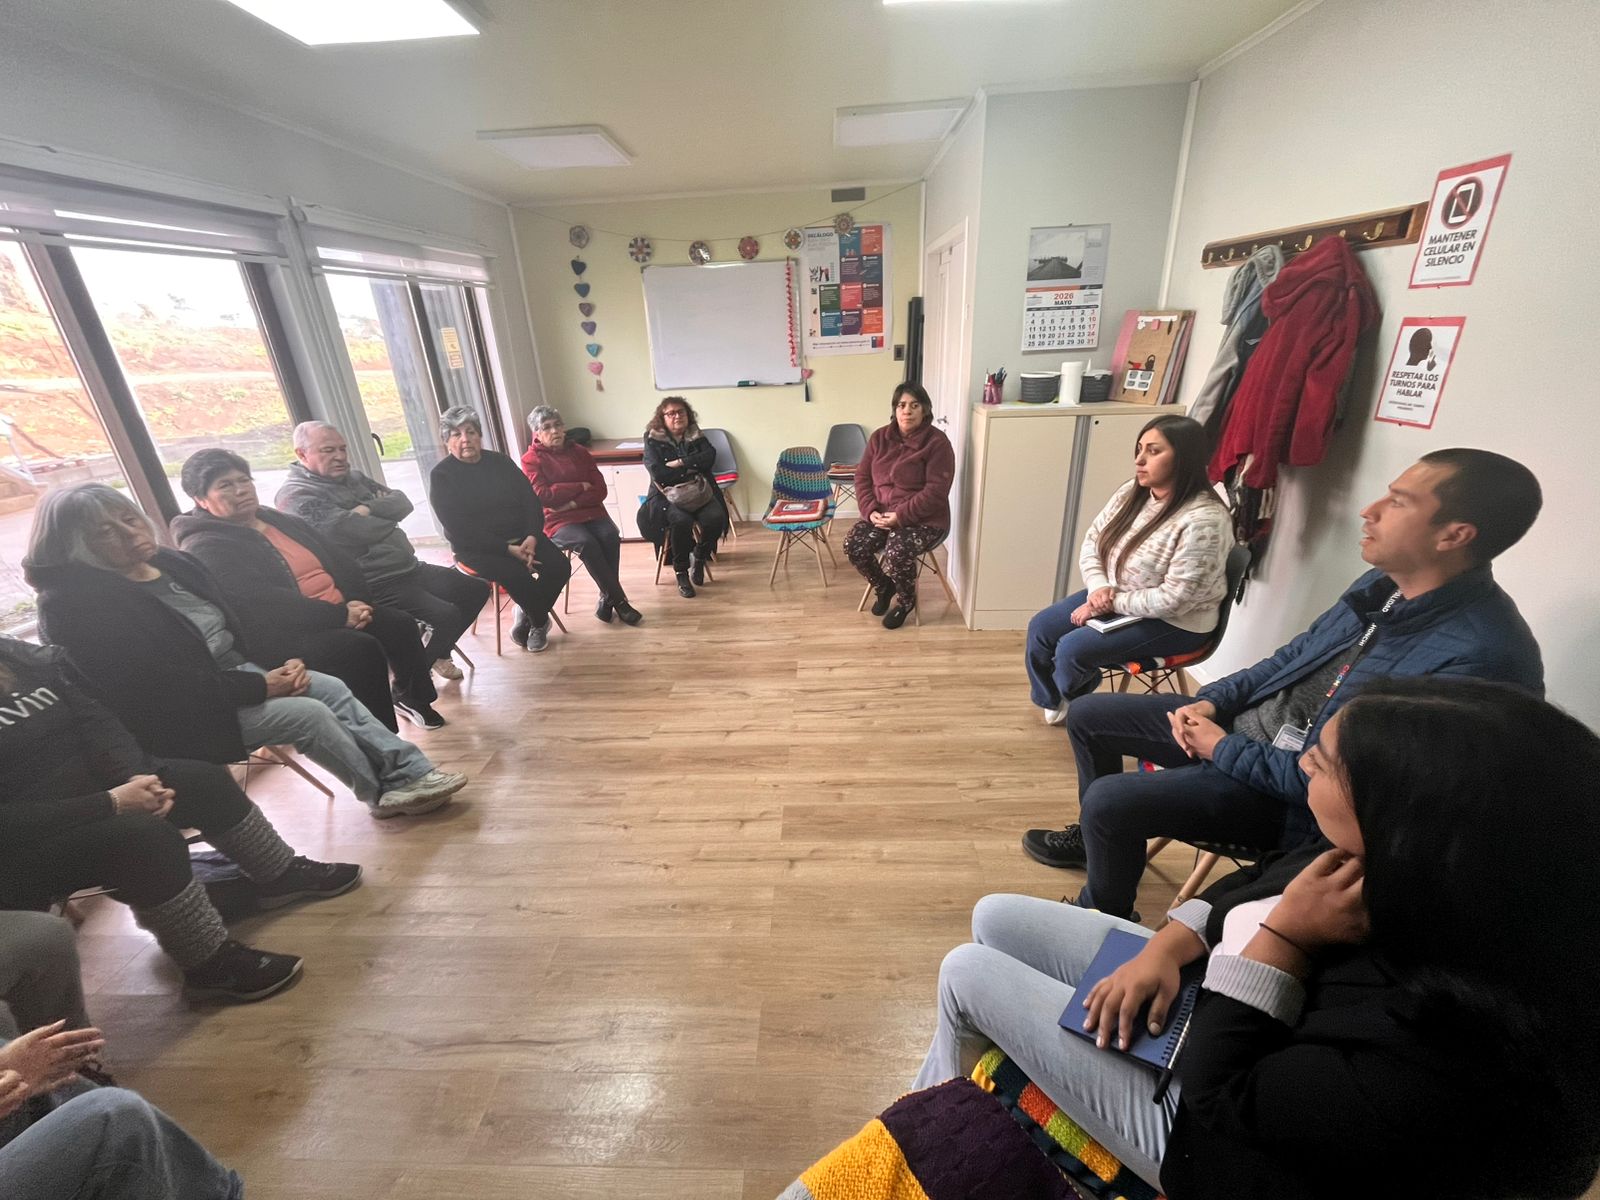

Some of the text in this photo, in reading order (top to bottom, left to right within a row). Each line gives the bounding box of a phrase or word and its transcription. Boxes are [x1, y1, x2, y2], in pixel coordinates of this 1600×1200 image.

[1428, 230, 1477, 244] MANTENER
[1424, 241, 1476, 256] CELULAR EN
[1425, 255, 1464, 267] SILENCIO
[1392, 371, 1424, 380] RESPETAR
[1390, 380, 1436, 390] TURNOS PARA
[1396, 389, 1423, 397] HABLAR
[1359, 622, 1377, 646] HONCHI
[0, 687, 59, 725] vin
